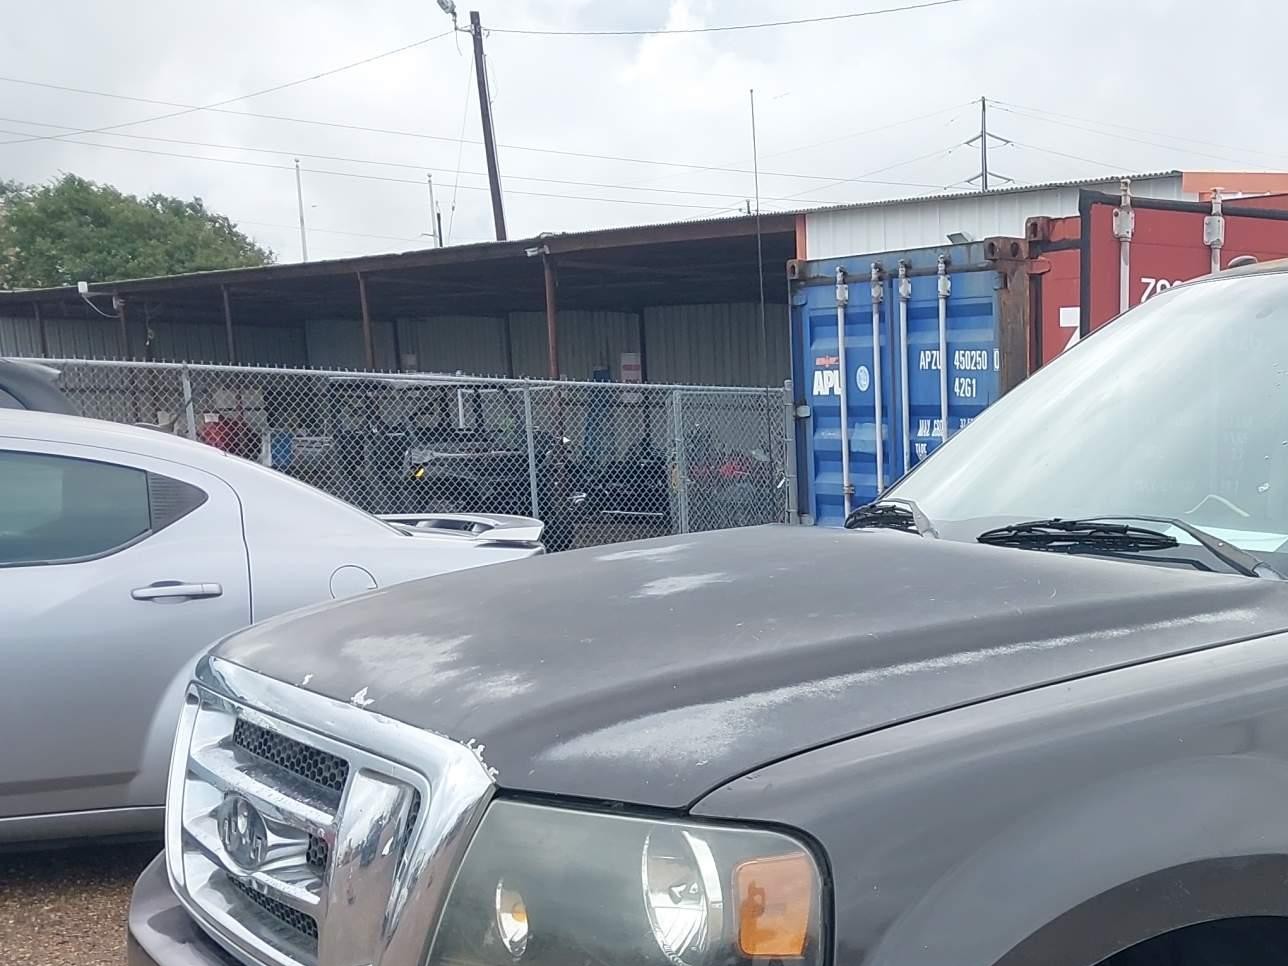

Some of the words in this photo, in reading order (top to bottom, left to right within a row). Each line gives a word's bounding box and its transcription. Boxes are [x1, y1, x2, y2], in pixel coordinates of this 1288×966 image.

[953, 350, 988, 370] 450250
[812, 370, 842, 396] APL
[954, 377, 977, 397] 42G1
